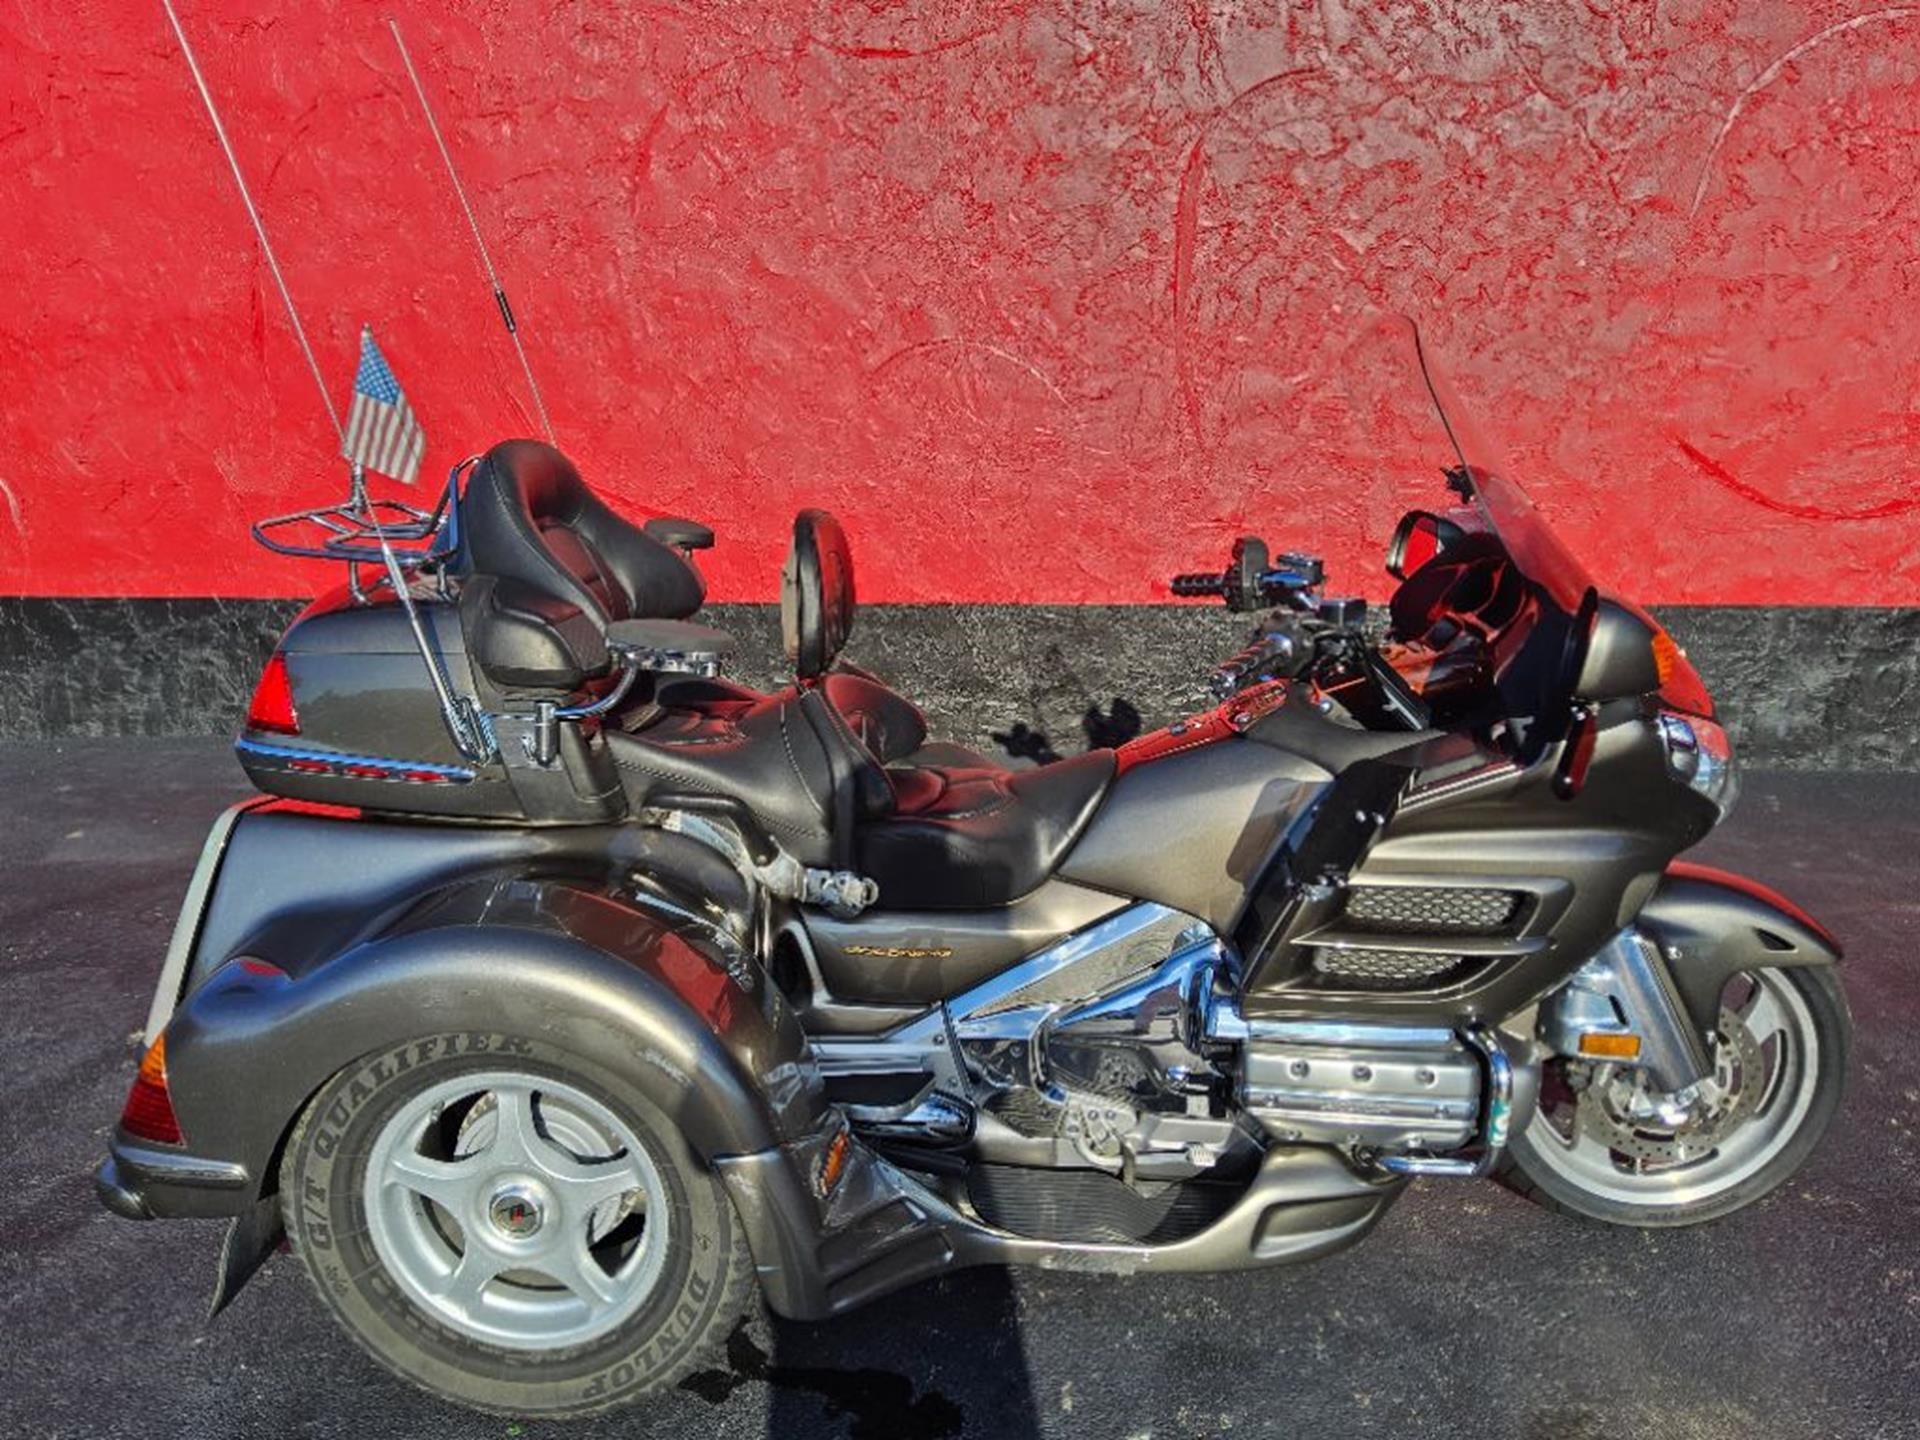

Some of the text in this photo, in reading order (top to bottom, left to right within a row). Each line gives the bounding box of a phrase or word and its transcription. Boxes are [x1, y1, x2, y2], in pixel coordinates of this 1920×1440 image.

[314, 1033, 533, 1160] QUALIFIER
[305, 1176, 332, 1251] G/T
[582, 1269, 711, 1398] DUNLOP
